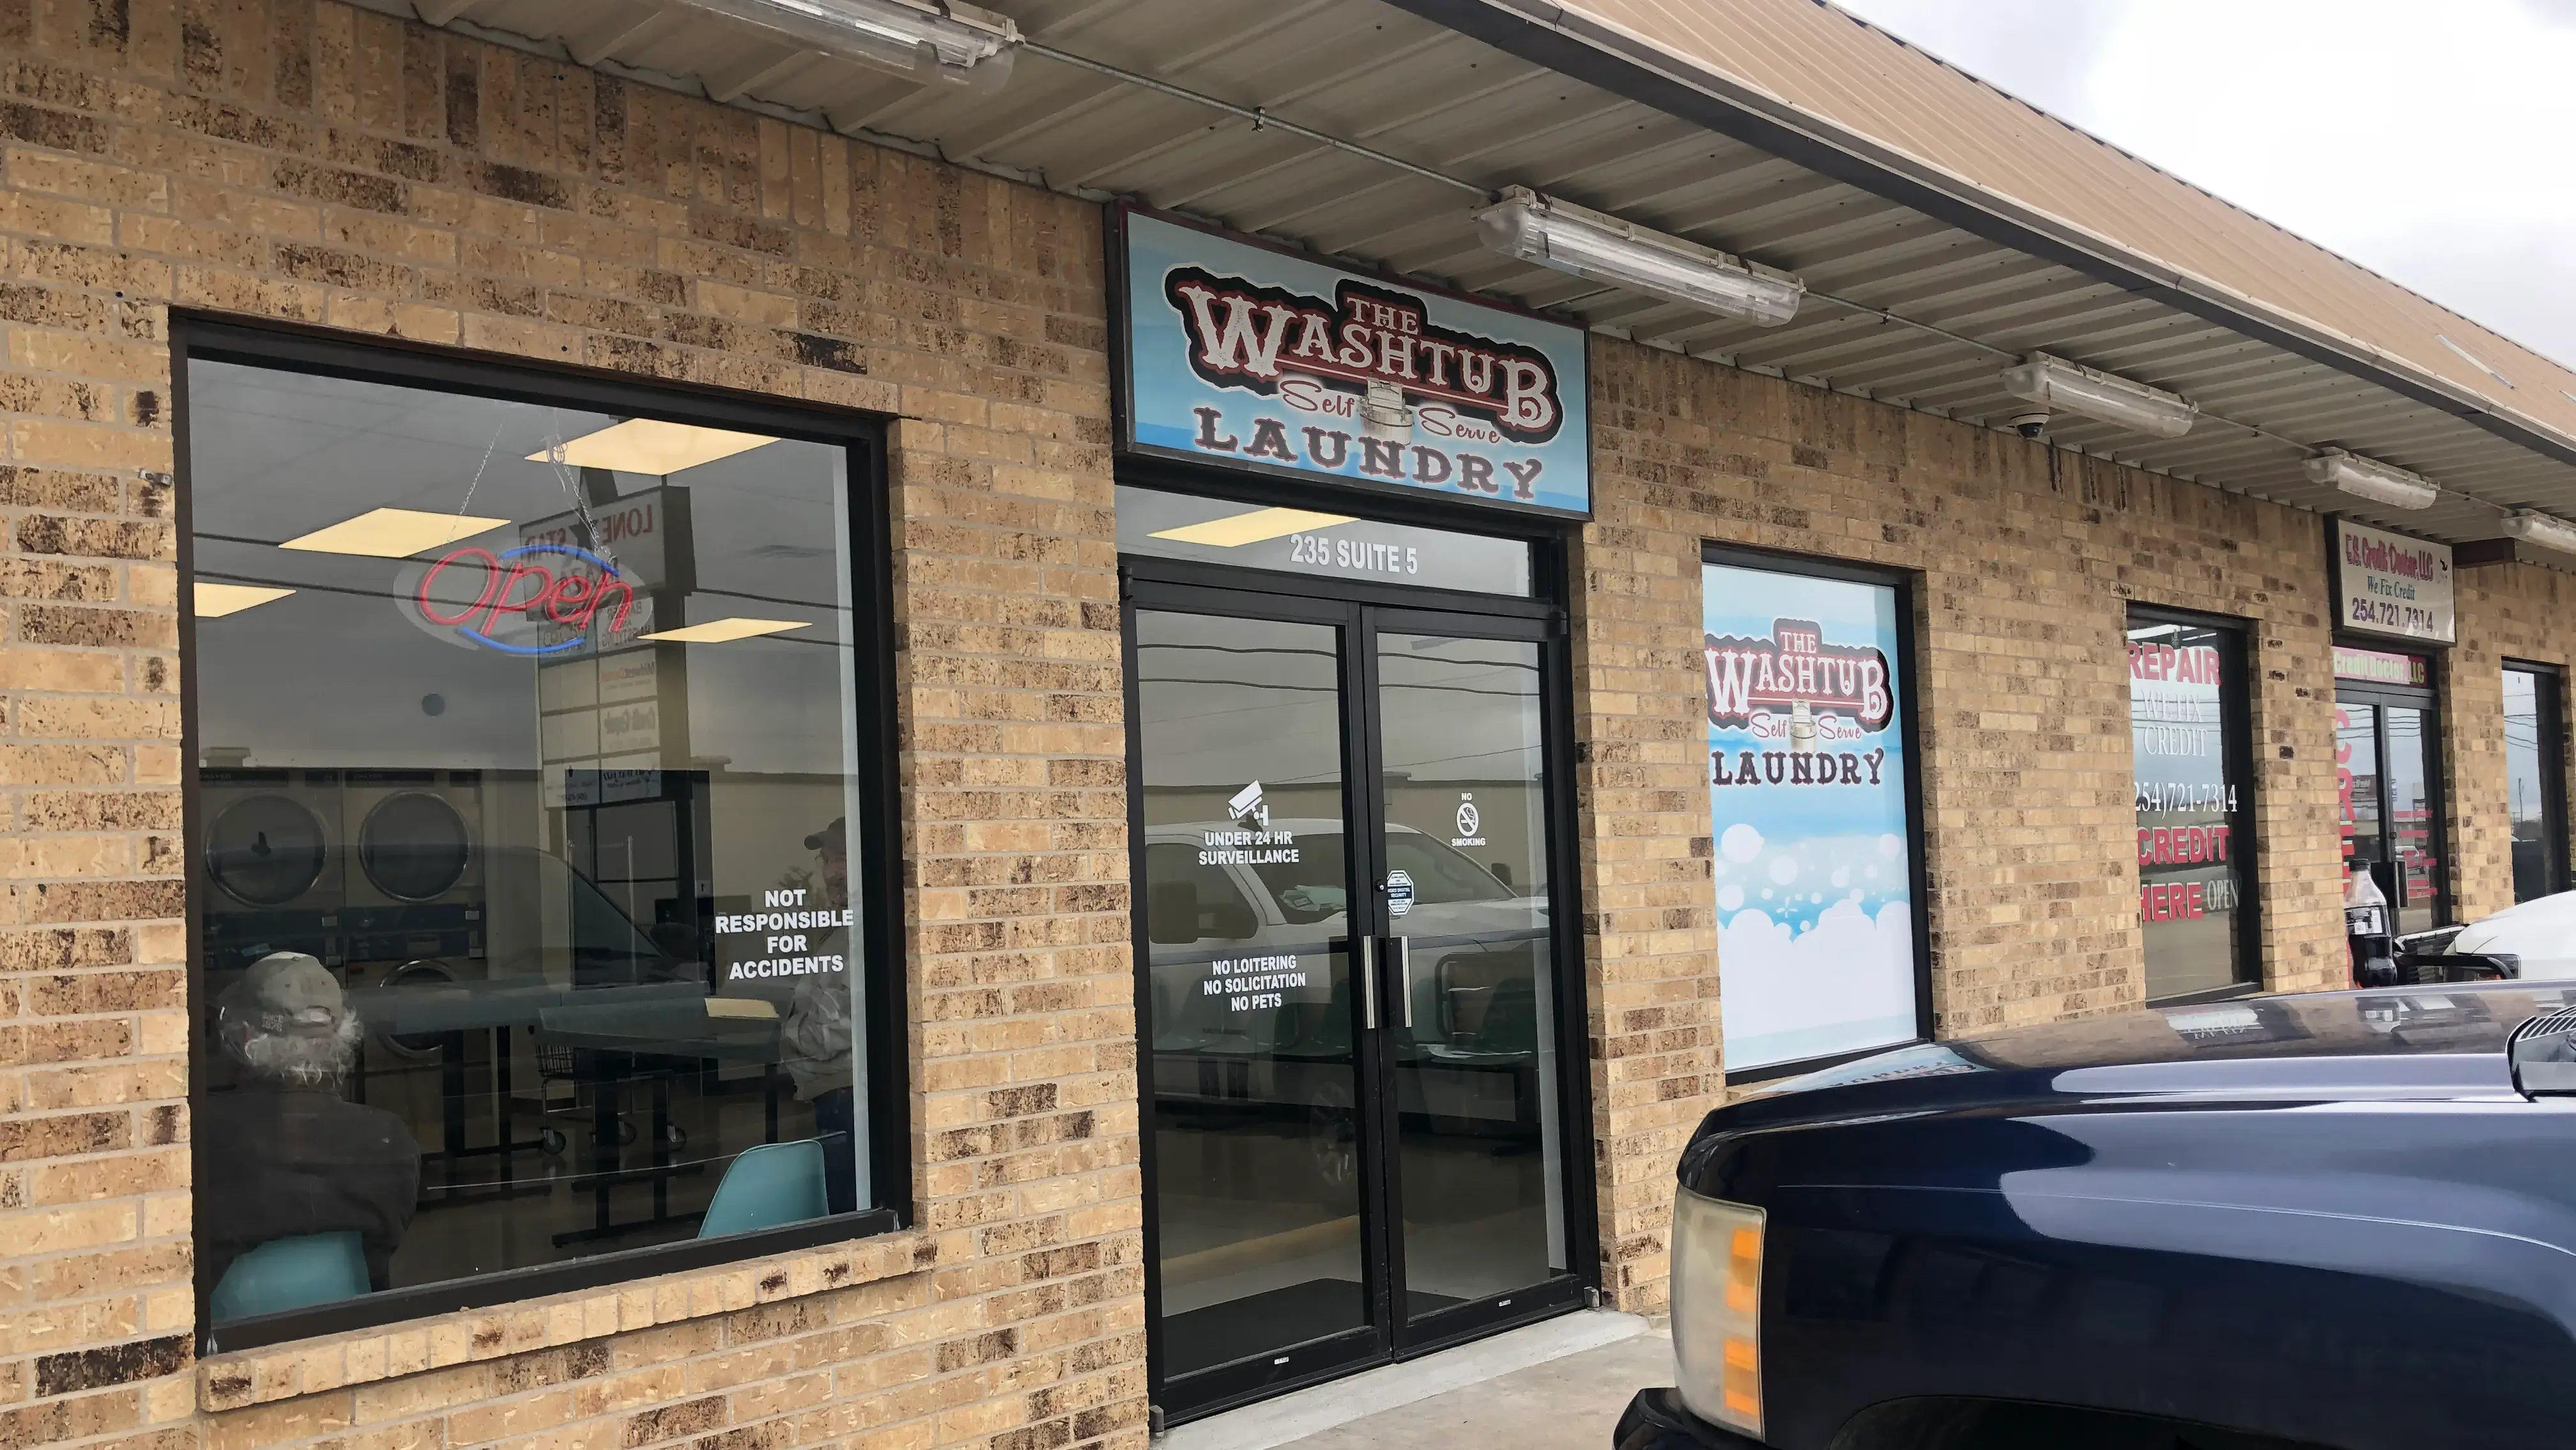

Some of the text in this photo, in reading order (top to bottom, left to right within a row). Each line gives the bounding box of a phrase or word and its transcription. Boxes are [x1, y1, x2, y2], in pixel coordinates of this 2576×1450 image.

[1346, 297, 1418, 336] THE
[1179, 285, 1554, 429] WASHTUB
[1280, 380, 1501, 445] Self Serve
[1193, 406, 1543, 499] LAUNDRY
[1290, 534, 1418, 575] 235 SUITE 5
[419, 546, 633, 636] Open
[2367, 575, 2416, 601] We Fix Credit
[2352, 597, 2434, 632] 254.721.7314
[1780, 631, 1817, 654] THE
[2128, 640, 2221, 686] REPAIR
[1705, 647, 1889, 721] WASHTUB
[2142, 688, 2204, 723] WE FIX
[1751, 713, 1862, 741] Self Serve
[2144, 725, 2207, 757] CREDIT
[1712, 747, 1885, 786] LAUNDRY
[1460, 792, 1473, 801] NO
[2134, 782, 2237, 820] 254)721-7314
[1204, 830, 1293, 846] UNDER 24 HR
[1451, 837, 1486, 847] SMOKING
[2136, 825, 2231, 867] CREDIT
[1199, 849, 1300, 865] SURVEILLANCE
[765, 888, 806, 907] NOT
[2140, 879, 2239, 923] HERE OPEN
[715, 909, 854, 934] RESPONSIBLE
[767, 934, 808, 954] FOR
[729, 954, 844, 980] ACCIDENTS
[1212, 955, 1297, 976] NO LOITERING
[1203, 972, 1306, 996] NO SOLICITATION
[1231, 992, 1282, 1012] NO PETS
